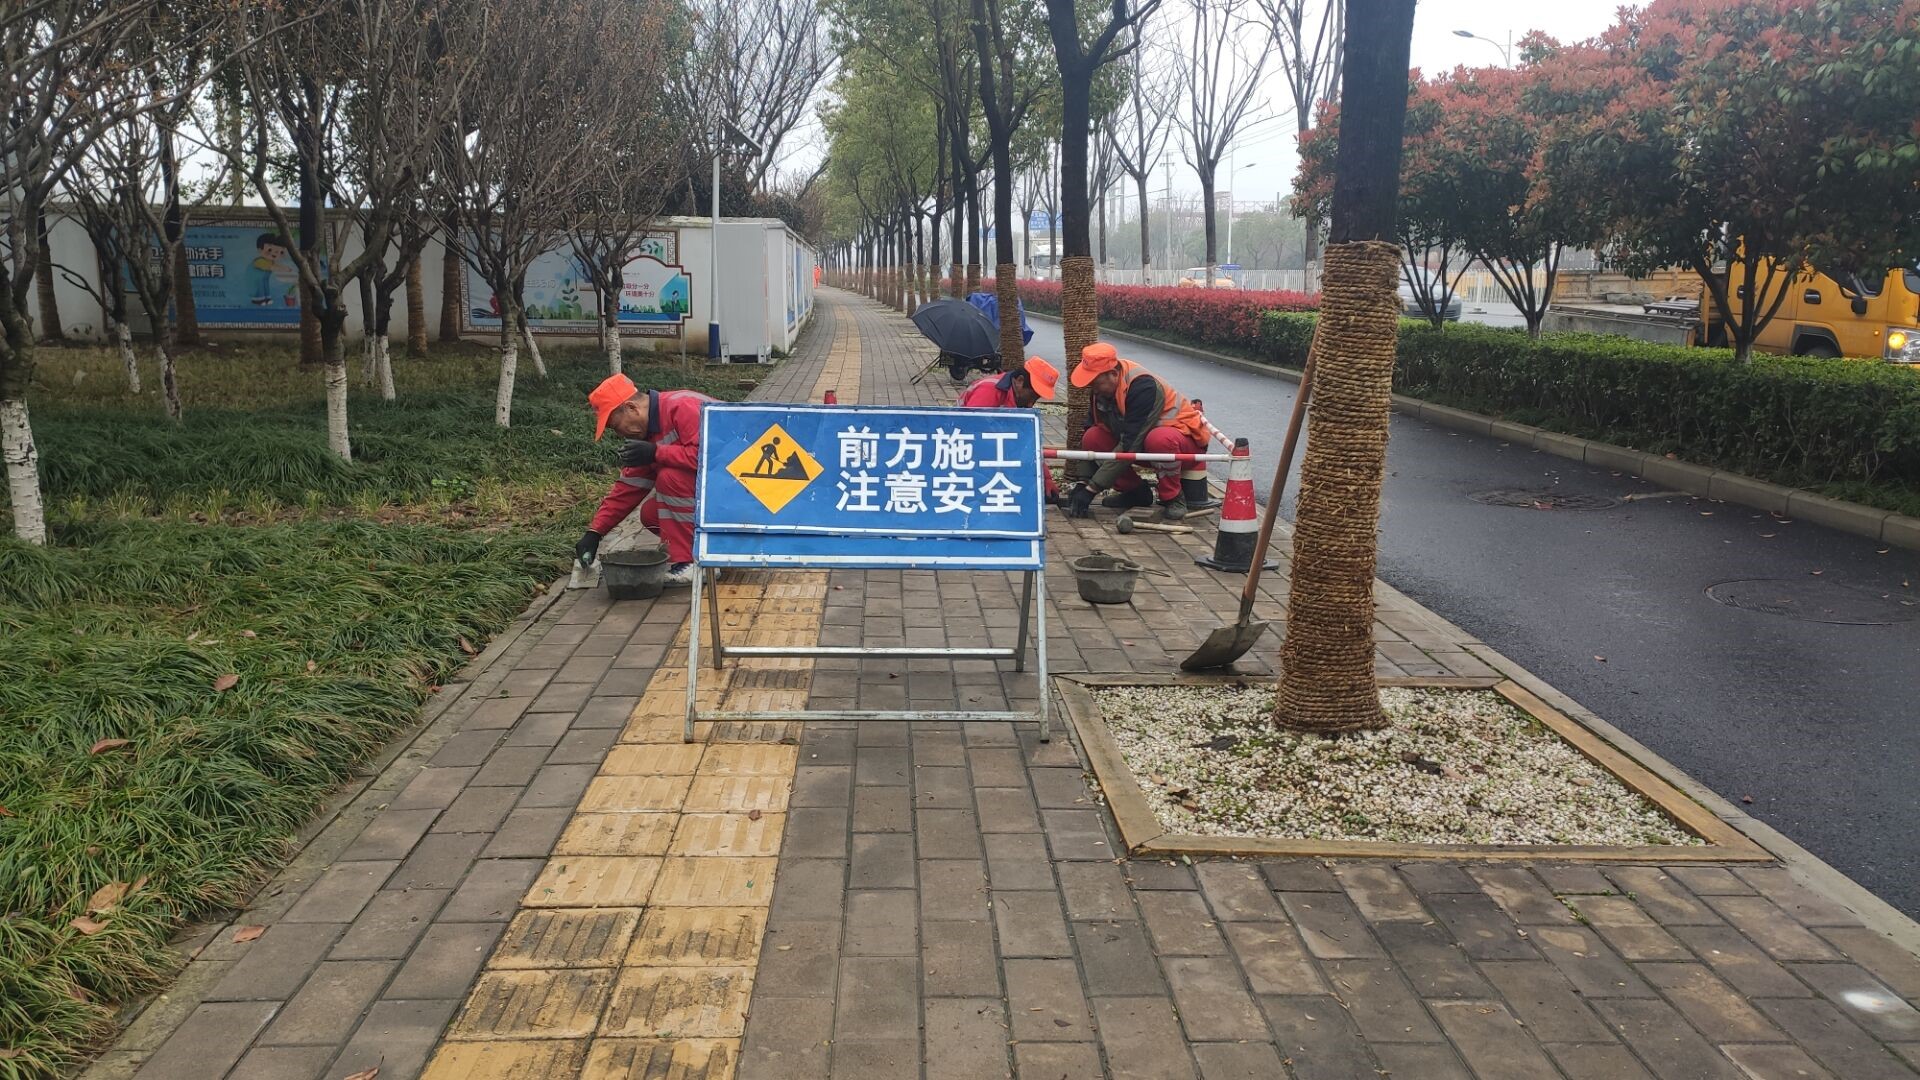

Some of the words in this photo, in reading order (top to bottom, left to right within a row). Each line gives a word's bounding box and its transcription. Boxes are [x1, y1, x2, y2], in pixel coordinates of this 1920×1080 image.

[837, 425, 1021, 470] 前方施工
[836, 470, 1022, 514] 注意安全
